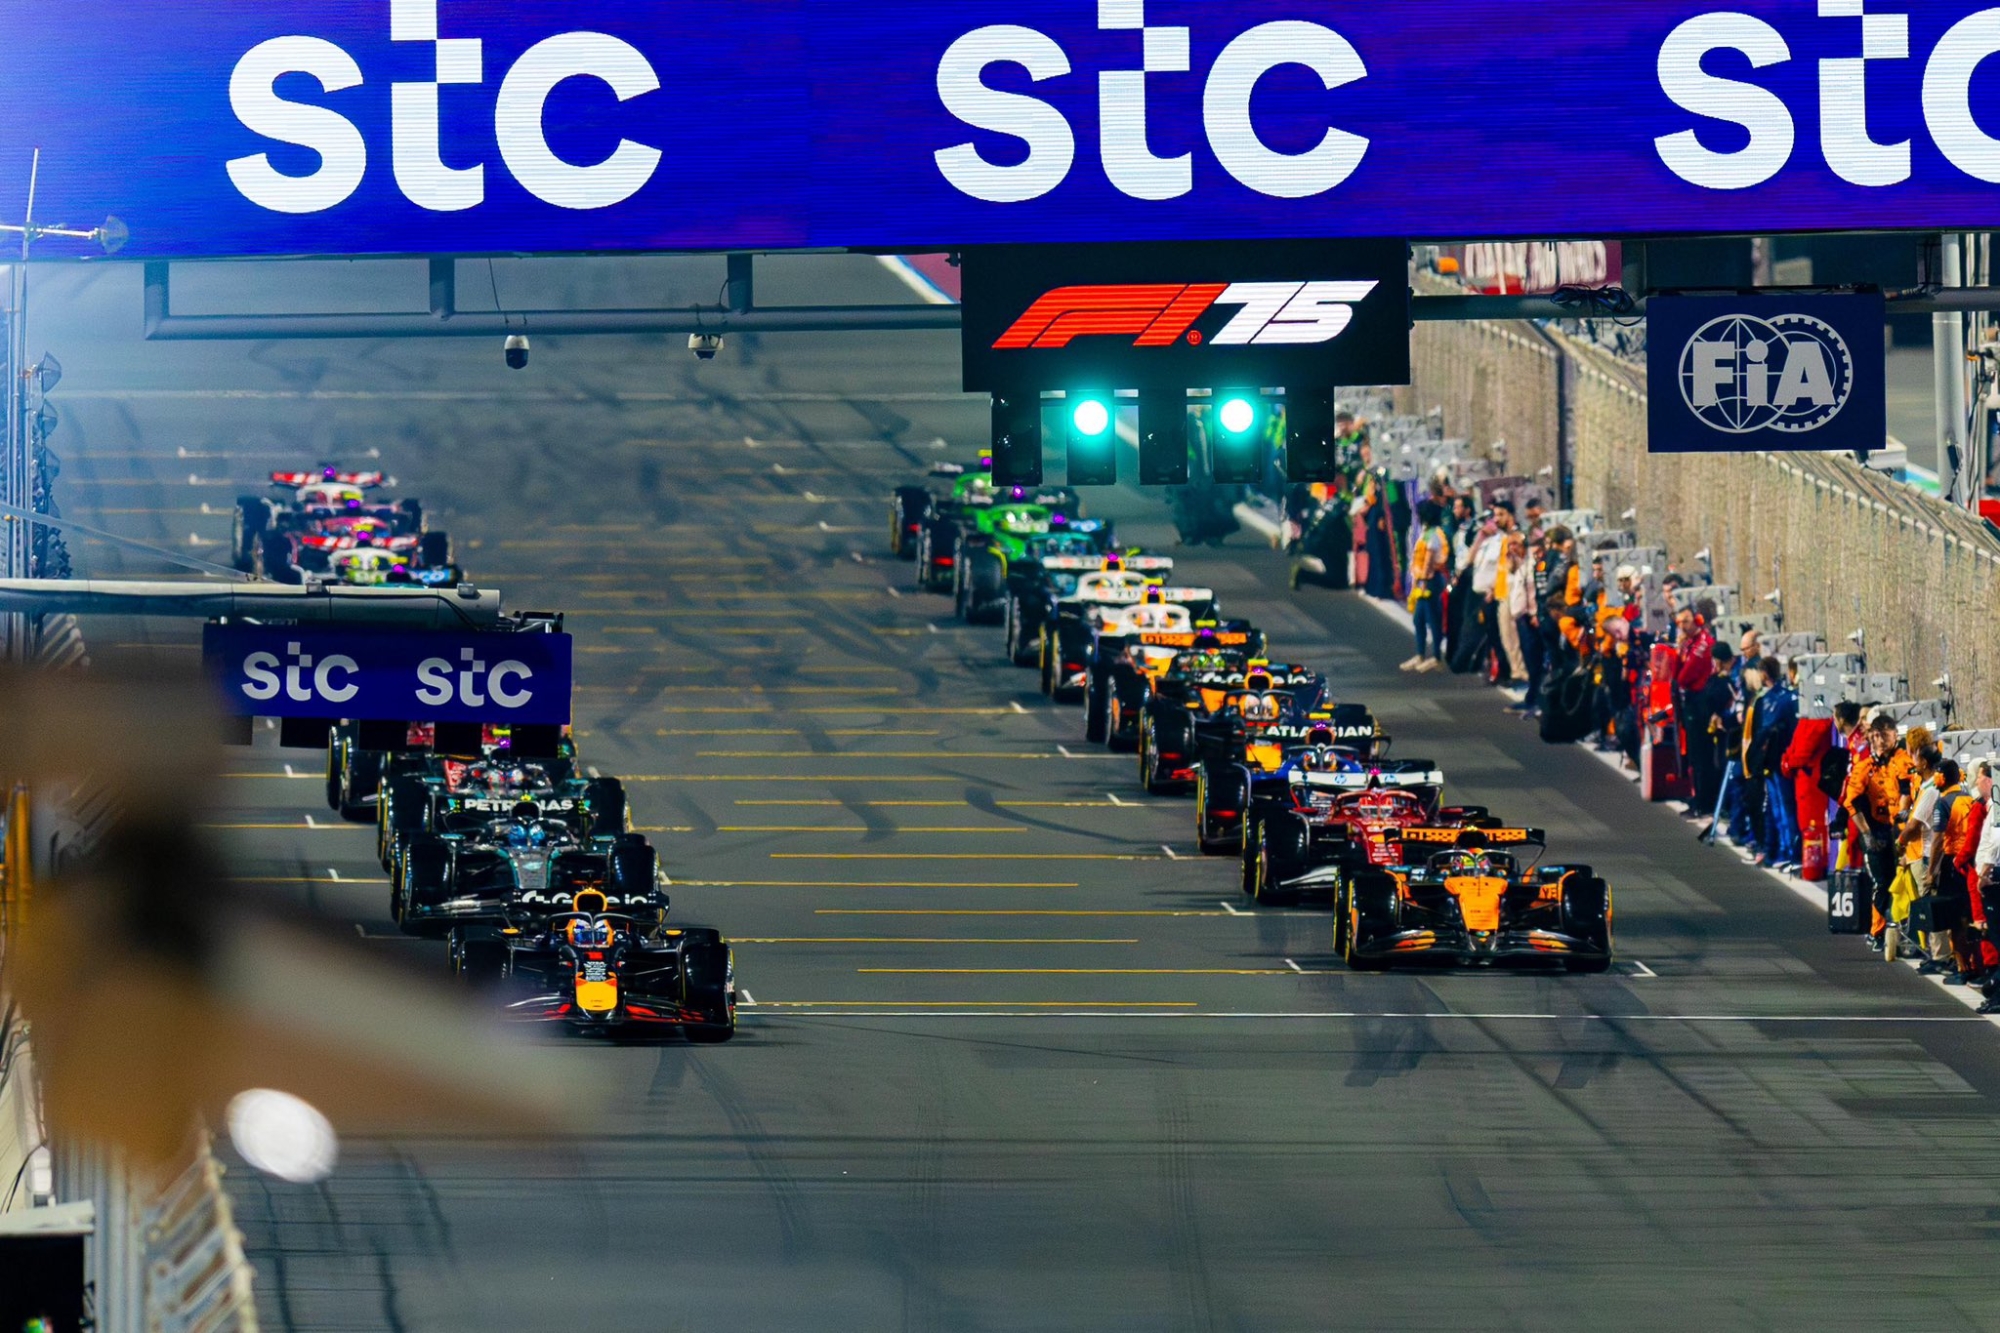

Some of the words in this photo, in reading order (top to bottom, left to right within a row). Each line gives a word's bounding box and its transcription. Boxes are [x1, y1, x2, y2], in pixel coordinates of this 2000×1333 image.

[226, 0, 662, 213] stc
[934, 0, 1369, 202] stc
[241, 641, 359, 702] stc
[415, 647, 533, 708] stc
[1266, 725, 1372, 738] ATLASIAN
[1832, 892, 1854, 917] 16
